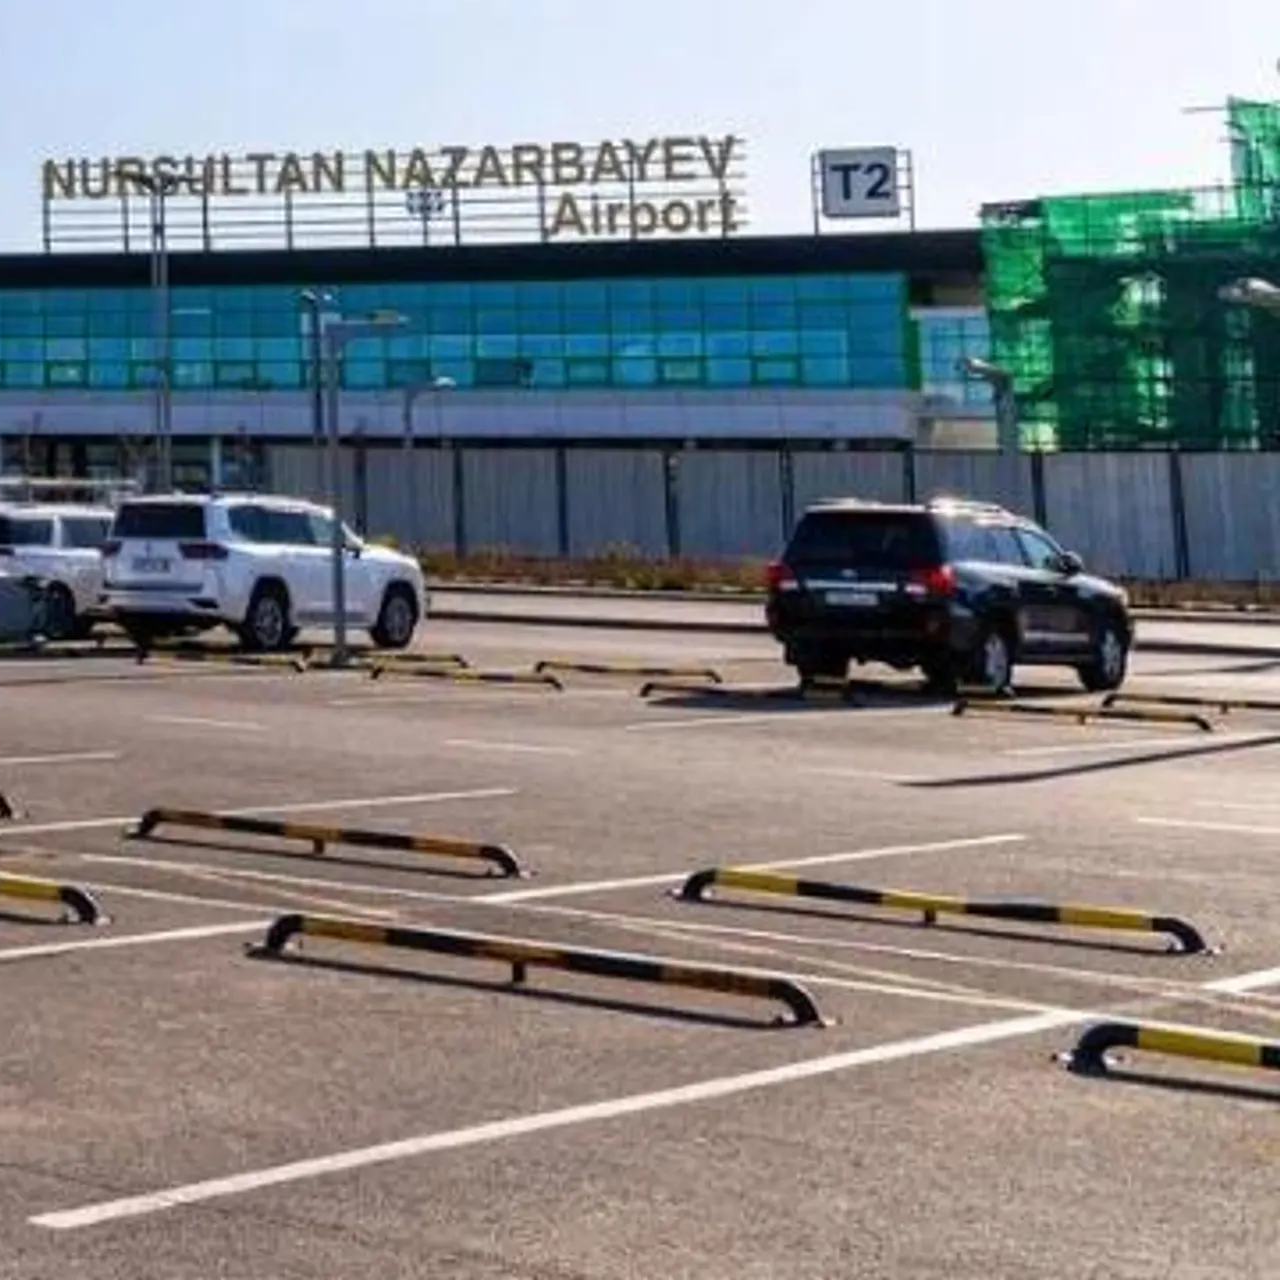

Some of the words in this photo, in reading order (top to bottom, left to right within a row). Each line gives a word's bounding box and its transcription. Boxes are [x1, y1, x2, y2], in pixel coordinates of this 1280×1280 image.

[43, 151, 343, 199] NURSULTAN
[365, 135, 735, 189] NAZARBAYEV
[829, 162, 892, 201] T2
[547, 191, 737, 237] Airport
